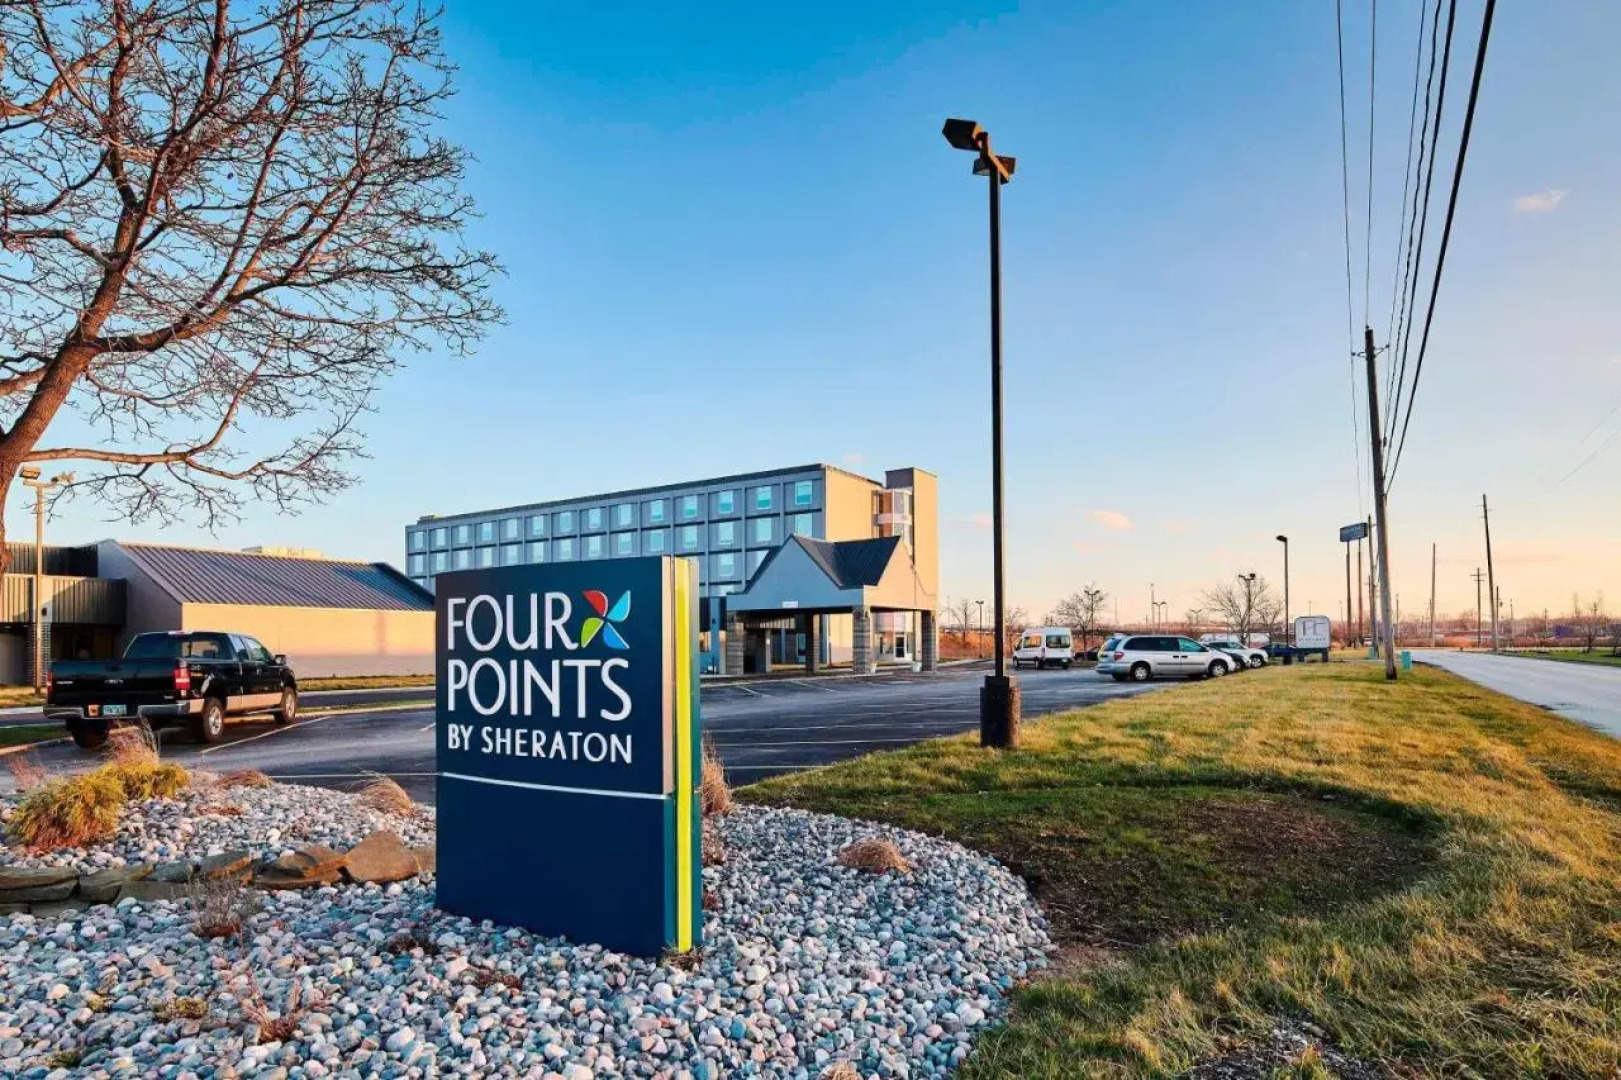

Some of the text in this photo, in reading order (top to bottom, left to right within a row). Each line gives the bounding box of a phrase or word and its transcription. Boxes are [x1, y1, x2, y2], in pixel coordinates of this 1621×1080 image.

[447, 591, 579, 652] FOUR
[447, 657, 632, 721] POINTS
[447, 723, 632, 764] BY SHERATON
